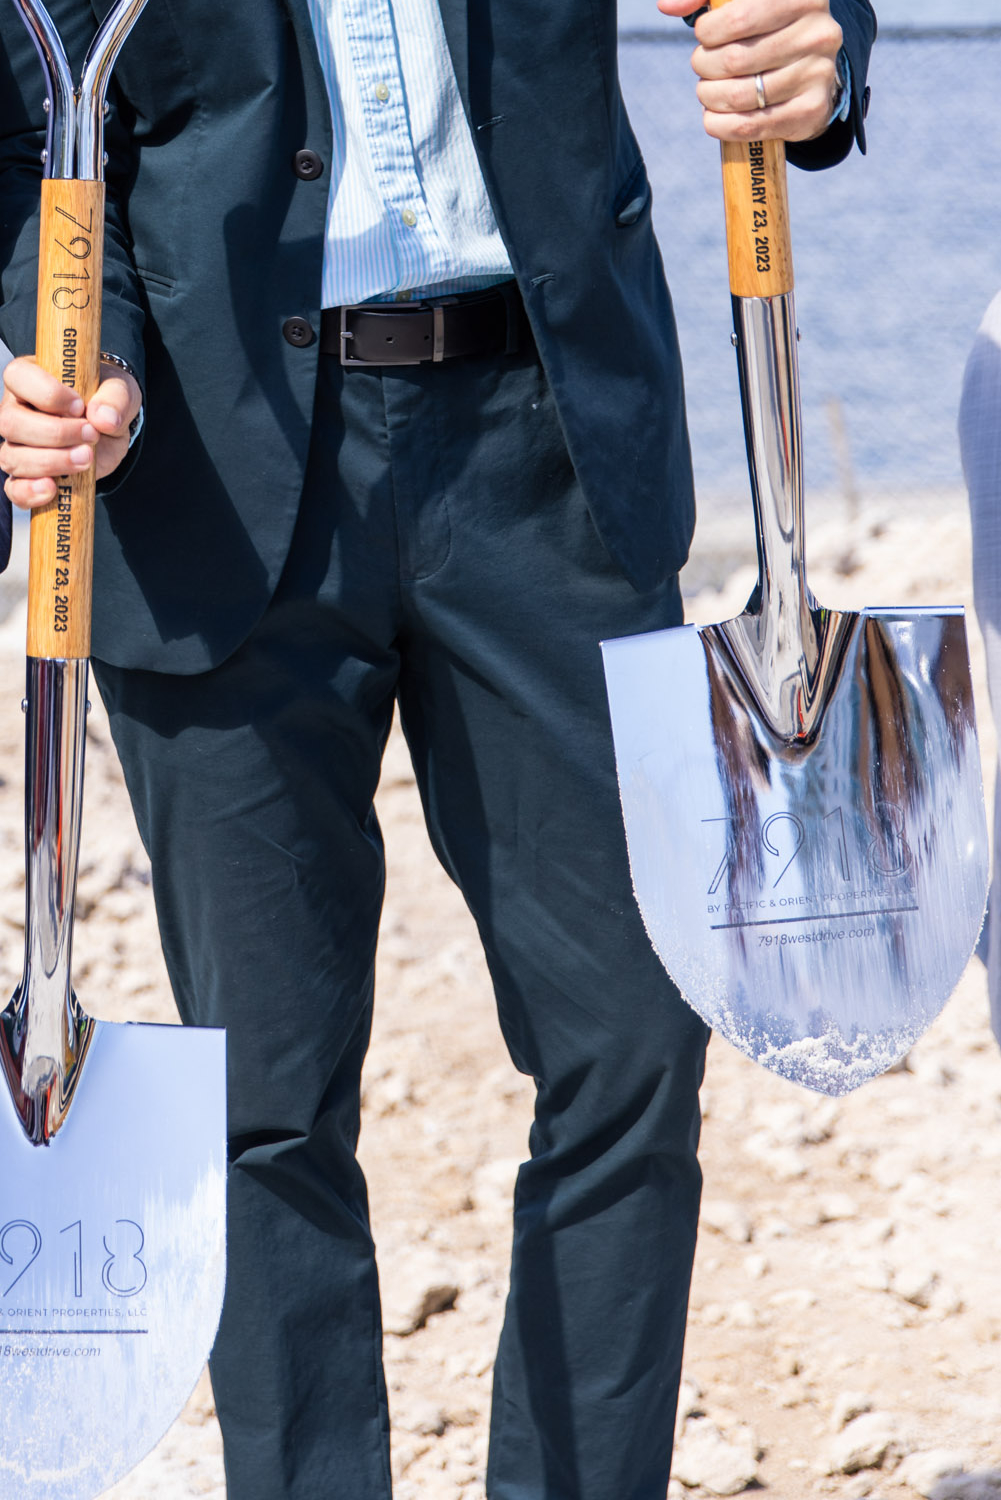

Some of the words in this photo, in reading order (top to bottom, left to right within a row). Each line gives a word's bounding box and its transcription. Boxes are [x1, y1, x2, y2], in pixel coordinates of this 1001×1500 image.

[748, 140, 767, 205] EBRUARY
[752, 210, 768, 233] 23,
[52, 206, 93, 310] 7918
[755, 237, 771, 273] 2023
[56, 485, 72, 563] FEBRUARY
[53, 568, 69, 590] 23,
[54, 595, 69, 633] 2023
[707, 905, 720, 913] BY
[823, 888, 890, 901] PROPERTIES
[758, 927, 875, 947] 7918westdrive.com
[8, 1308, 48, 1317] ORIENT
[52, 1308, 124, 1318] PROPERTIES,
[128, 1308, 148, 1317] LLC
